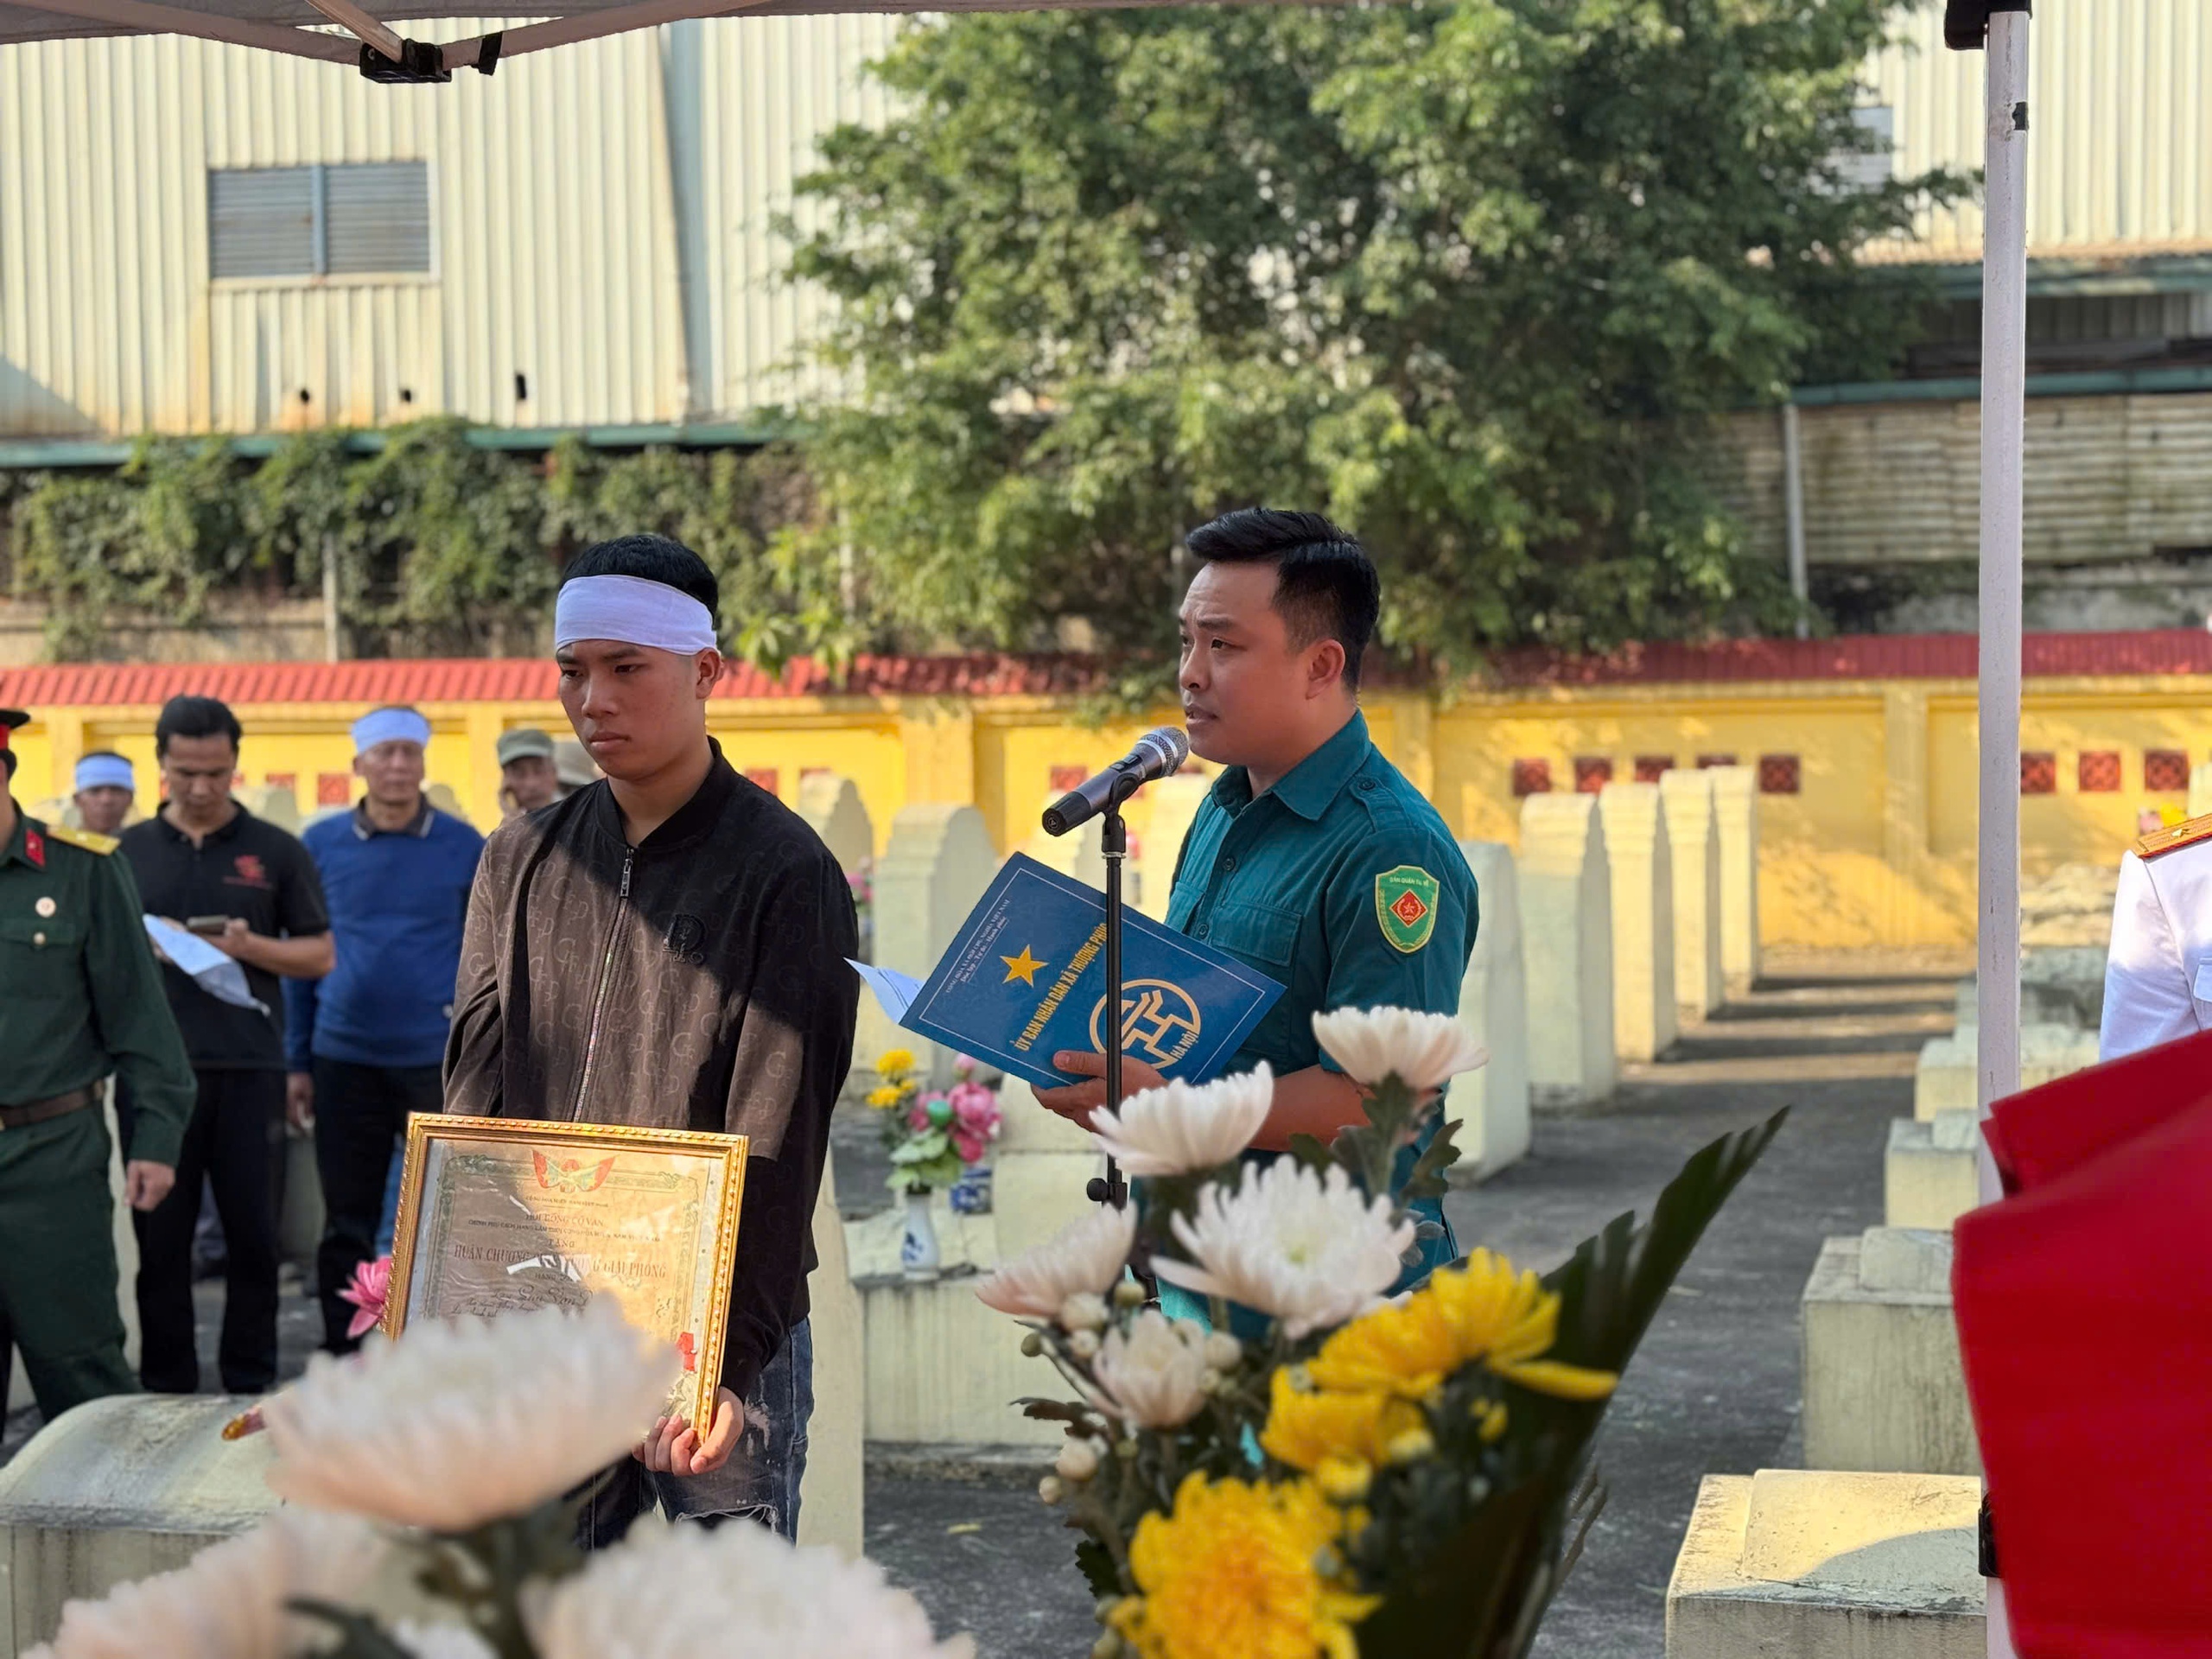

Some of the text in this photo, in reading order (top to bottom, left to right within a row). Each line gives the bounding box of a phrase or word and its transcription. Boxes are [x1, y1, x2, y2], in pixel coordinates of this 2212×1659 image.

[1067, 941, 1101, 974] THƯỢNG
[1059, 969, 1078, 986] XÃ
[1048, 981, 1071, 1001] DÂN
[1033, 997, 1059, 1026] NHÂN
[1022, 1020, 1045, 1040] BAN
[1009, 1036, 1033, 1052] ỦY
[454, 1244, 483, 1260] HUÂN
